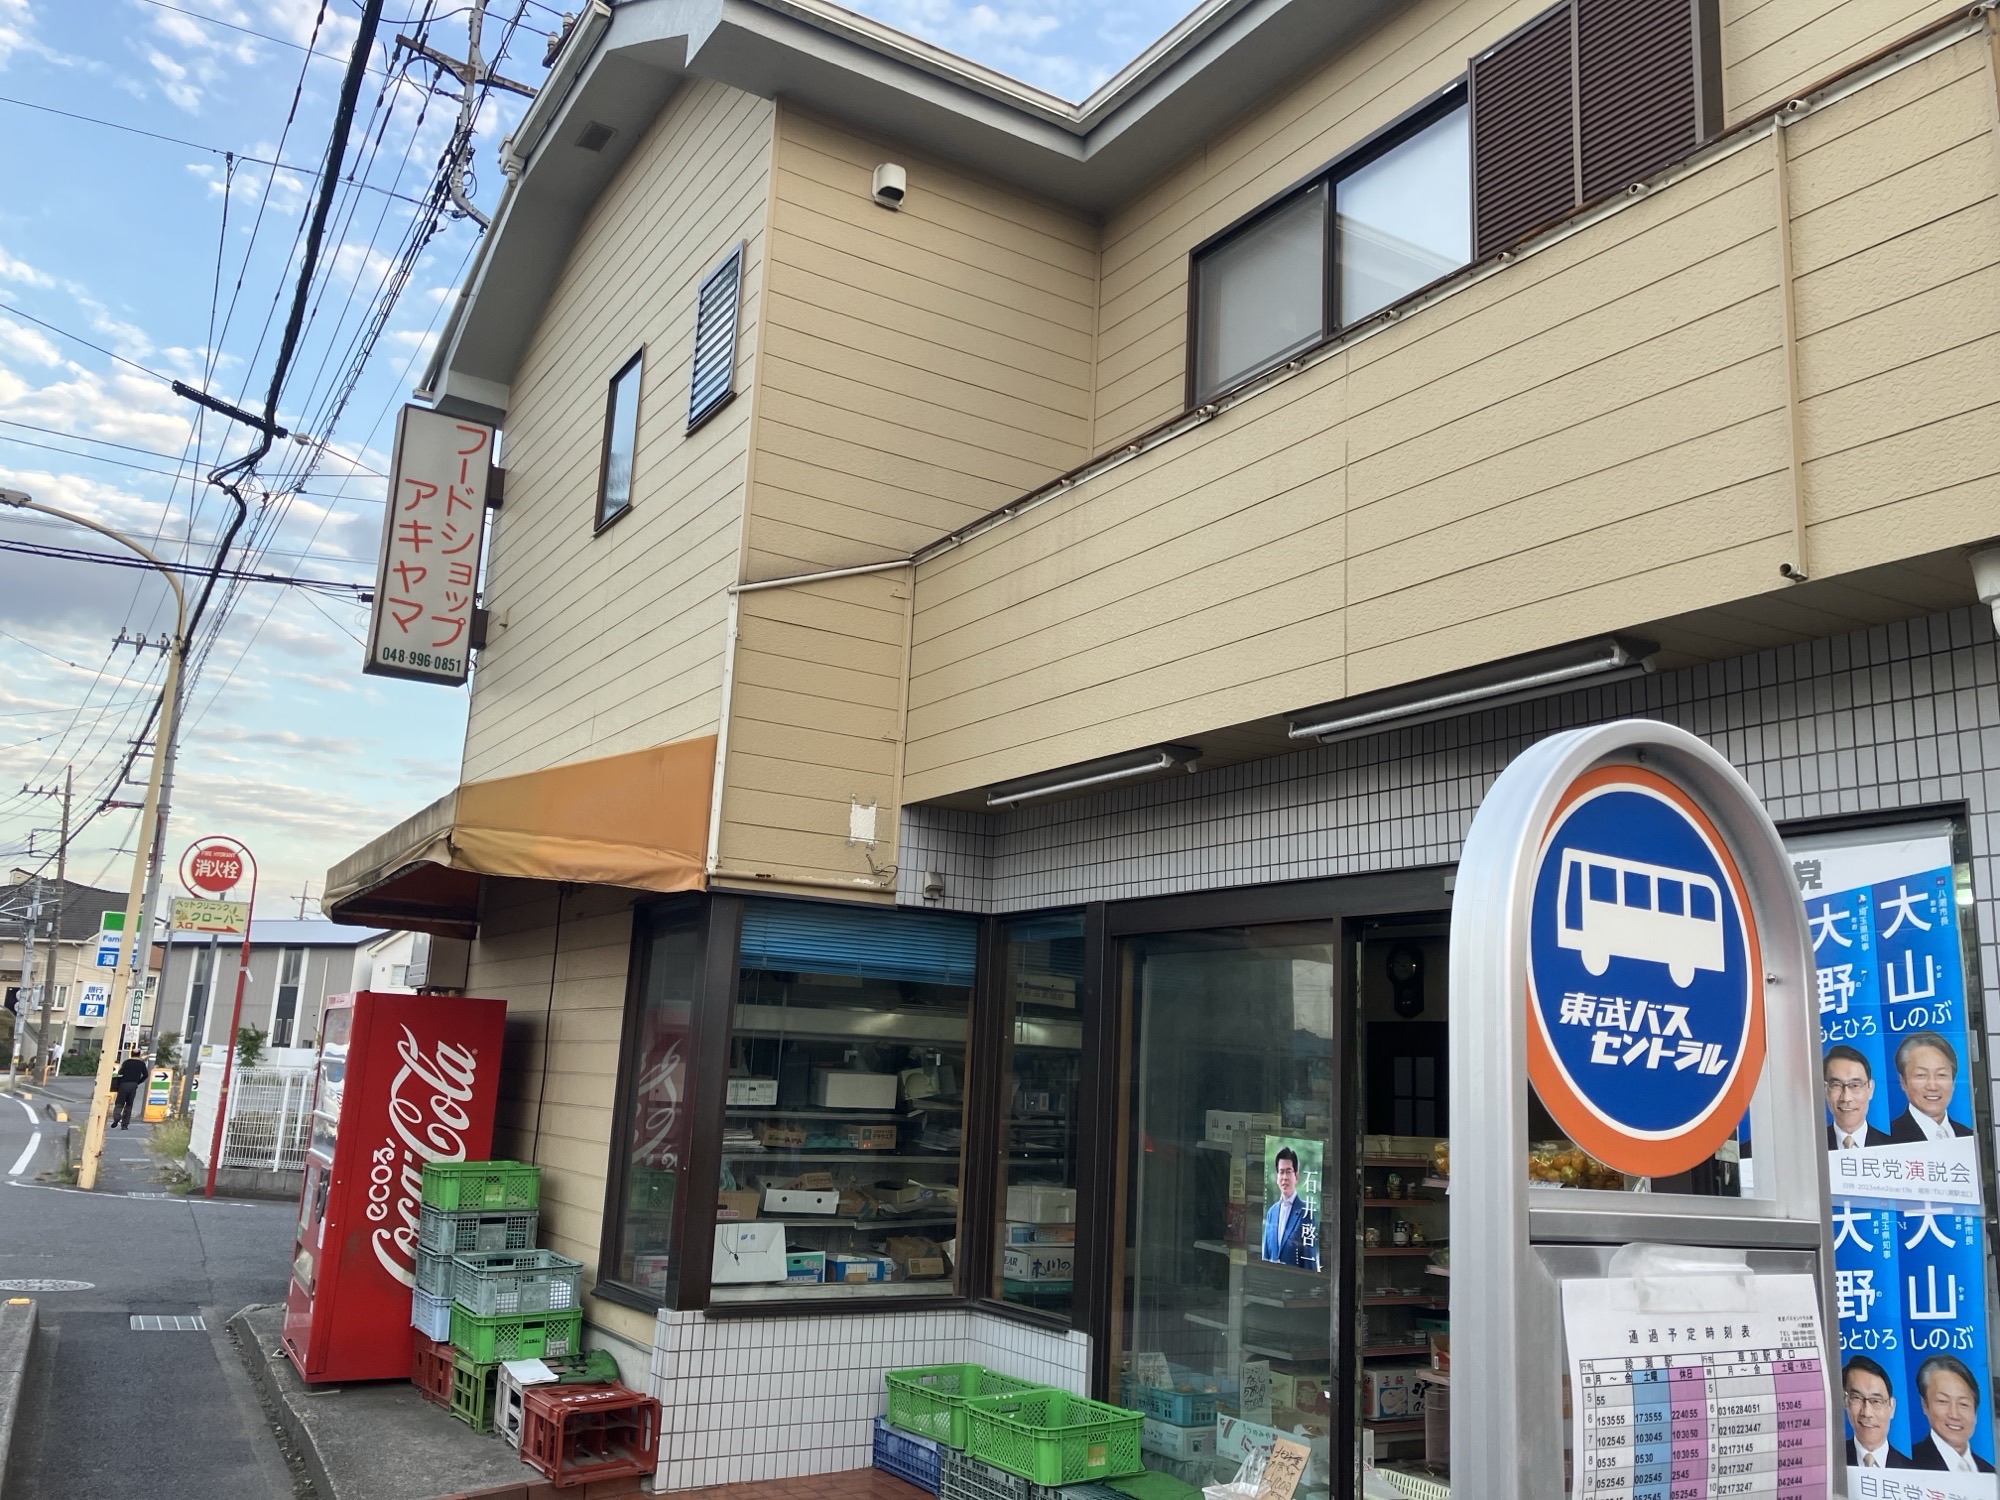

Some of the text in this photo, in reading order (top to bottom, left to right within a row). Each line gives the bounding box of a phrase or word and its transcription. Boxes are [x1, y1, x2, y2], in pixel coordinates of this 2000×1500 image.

[431, 424, 488, 648] フードショップ
[388, 477, 438, 634] アキヤマ
[213, 851, 237, 859] HYDRANT
[194, 858, 240, 879] 消火栓
[176, 900, 230, 911] ペットクリニック
[175, 921, 194, 930] 入口
[190, 911, 244, 924] クローバー
[84, 993, 104, 1001] ATM
[88, 986, 104, 994] 銀行
[1559, 992, 1693, 1039] 東武バス
[1889, 1000, 1953, 1032] しのぶ
[1590, 1031, 1729, 1076] セントラル
[1840, 1156, 1971, 1184] 自民党演説会
[1300, 1169, 1319, 1262] 石井啓一
[1628, 1325, 1751, 1344] 通過予定時刻表
[1910, 1325, 1974, 1350] しのぶ
[1643, 1371, 1659, 1382] 土曜
[1680, 1369, 1693, 1380] 休日
[1587, 1384, 1713, 1405] 5 55 5
[1587, 1415, 1593, 1424] 6
[1709, 1404, 1715, 1413] 6
[1588, 1435, 1593, 1444] 7
[1588, 1455, 1593, 1465] 8
[1711, 1443, 1716, 1453] 8
[1587, 1477, 1593, 1486] 9
[1711, 1463, 1716, 1473] 9
[1709, 1482, 1716, 1492] 10
